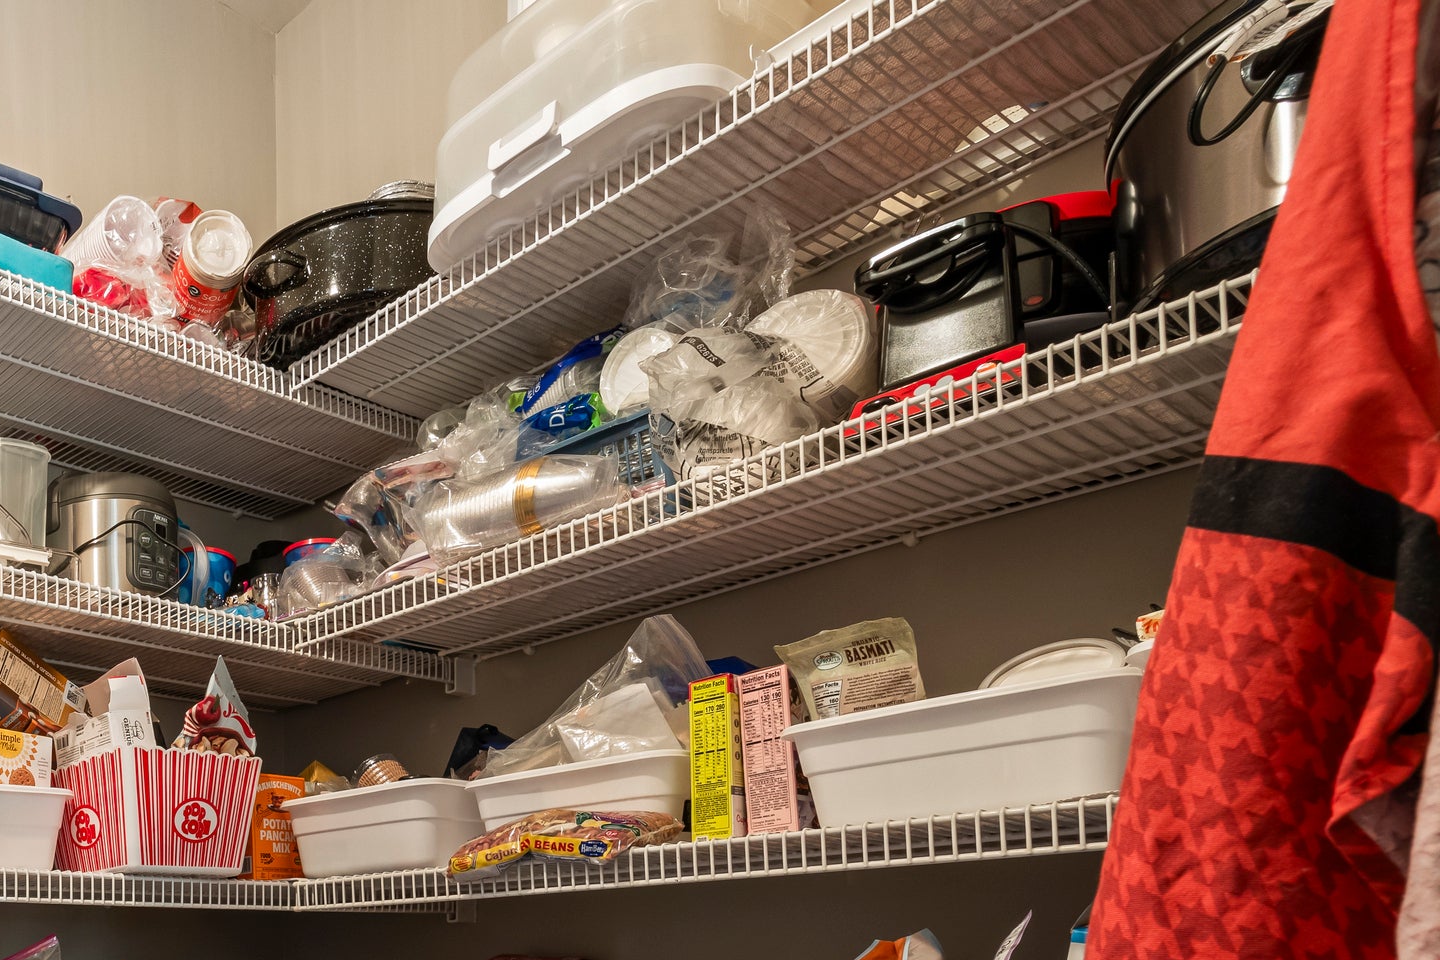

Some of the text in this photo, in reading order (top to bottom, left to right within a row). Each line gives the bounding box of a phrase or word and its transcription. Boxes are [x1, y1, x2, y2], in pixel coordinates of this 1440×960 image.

[844, 640, 896, 663] BASMATI
[693, 680, 725, 692] Nutrition Facts
[183, 802, 206, 820] POP
[181, 818, 211, 838] CORN
[272, 843, 291, 853] MIX
[534, 840, 575, 853] BEANS
[485, 847, 518, 862] Cajun
